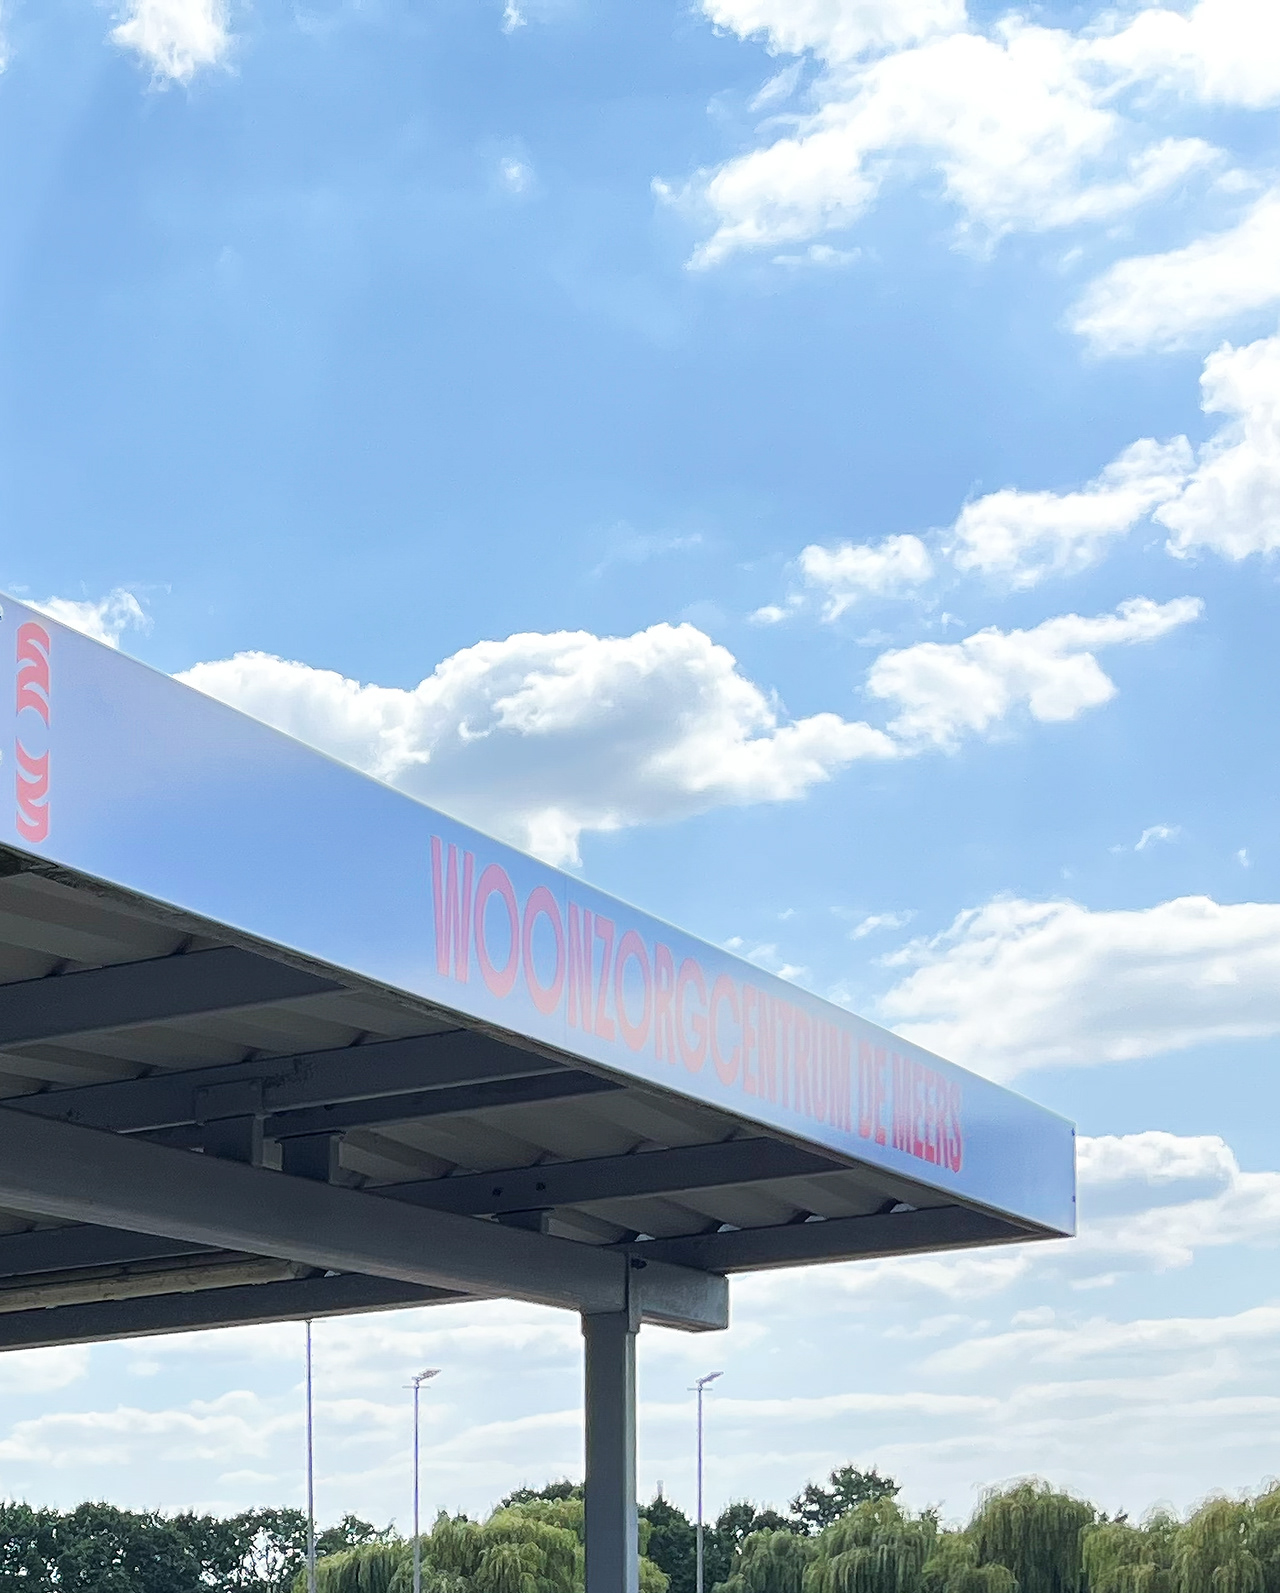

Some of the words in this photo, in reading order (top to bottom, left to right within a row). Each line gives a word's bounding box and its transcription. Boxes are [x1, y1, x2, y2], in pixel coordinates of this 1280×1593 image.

[431, 834, 851, 1132] WOONZORGCENTRUM
[858, 1039, 886, 1146] DE
[893, 1052, 963, 1173] MEERS
